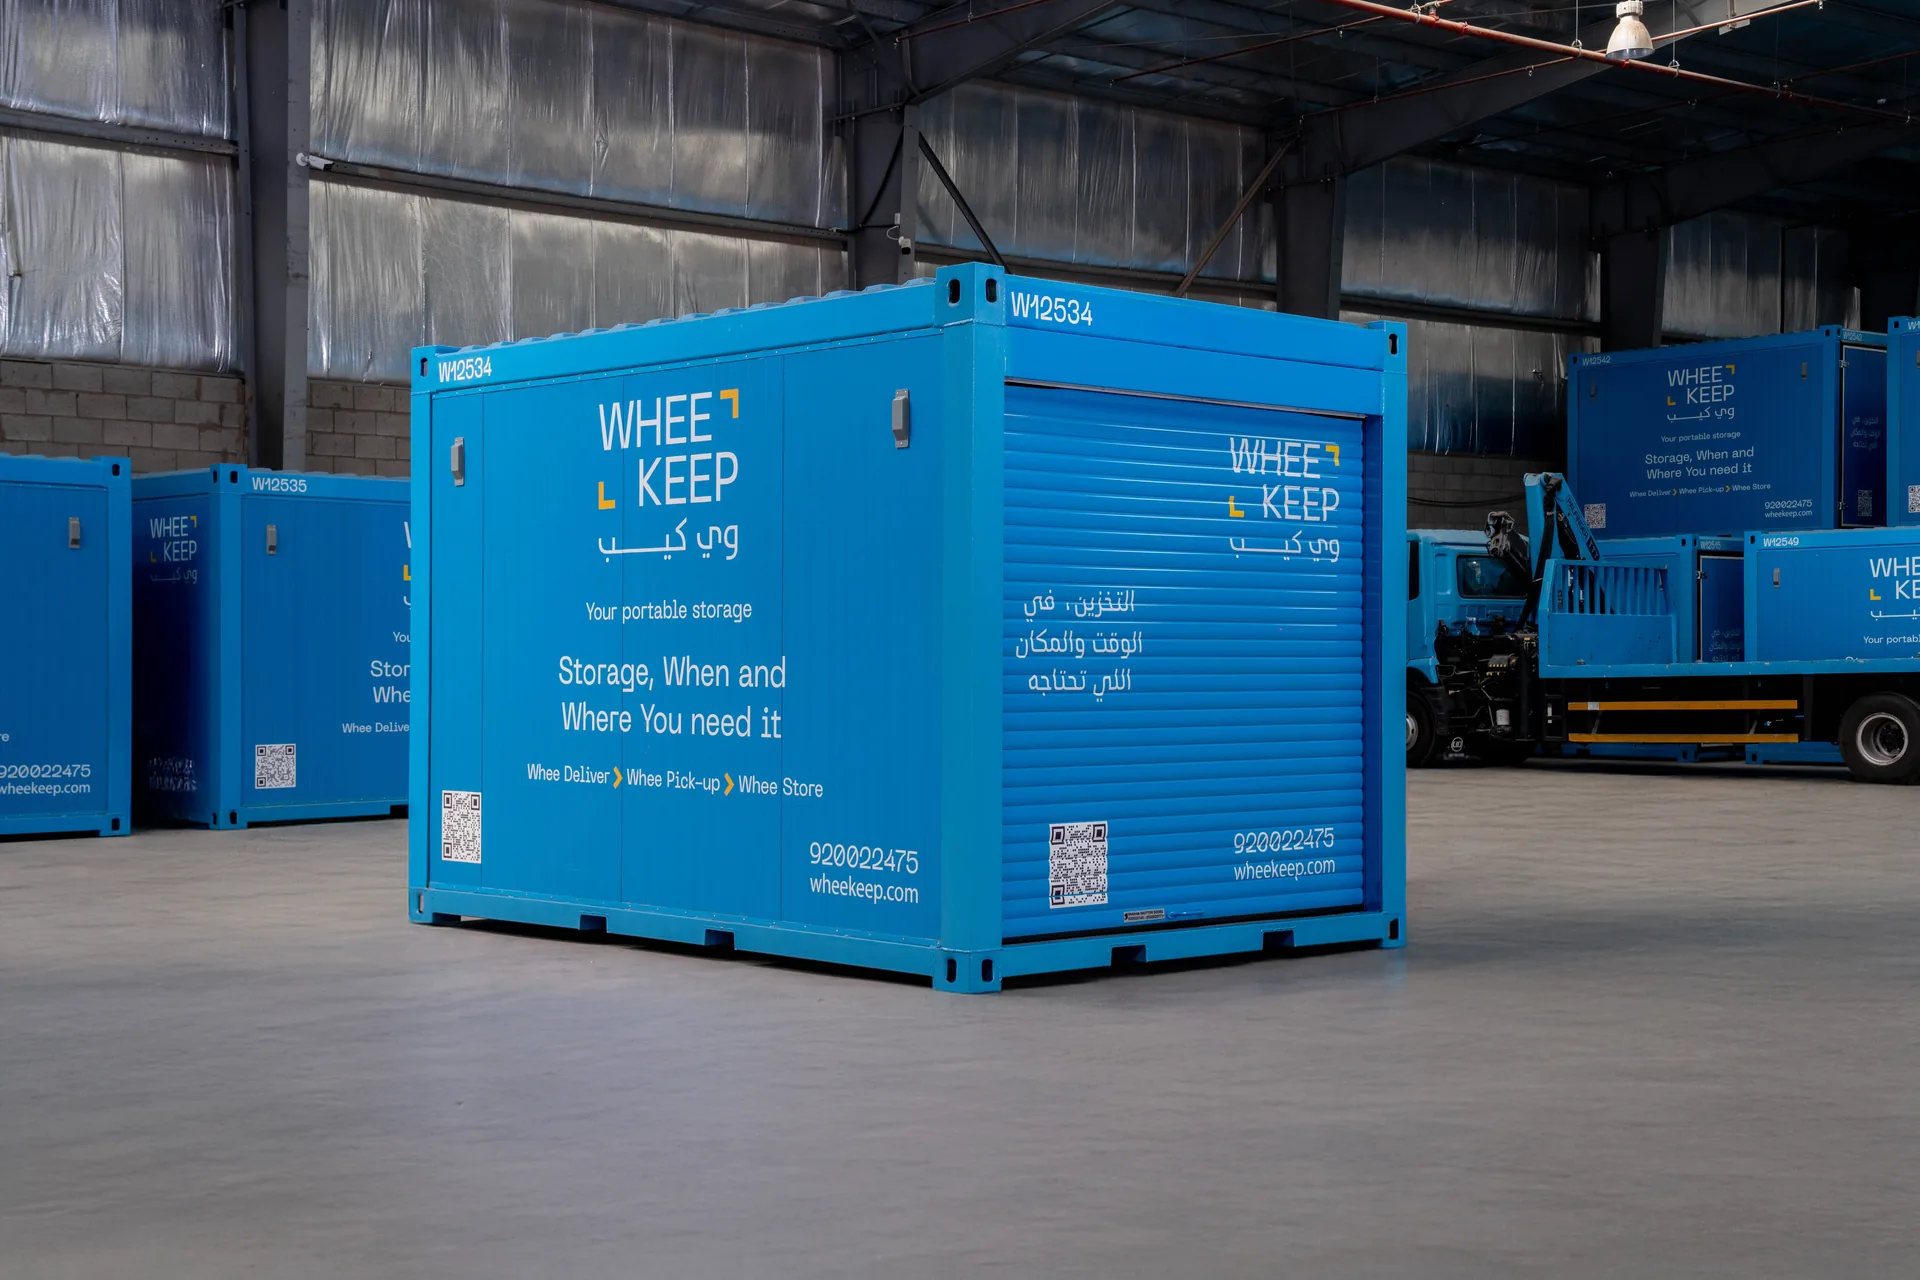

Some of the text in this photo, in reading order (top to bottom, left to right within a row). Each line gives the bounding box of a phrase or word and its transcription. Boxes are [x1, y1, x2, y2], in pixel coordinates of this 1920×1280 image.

[1011, 292, 1092, 325] W12534
[439, 357, 491, 382] W12534
[1668, 366, 1722, 387] WHEE
[1688, 385, 1734, 404] KEEP
[599, 392, 712, 450] WHEE
[1678, 433, 1711, 442] portable
[1712, 431, 1741, 440] storage
[1228, 435, 1320, 478] WHEE
[1645, 446, 1755, 465] Storage, When and
[639, 452, 738, 506] KEEP
[1647, 462, 1752, 480] Where You need it
[253, 478, 306, 492] W12535
[1260, 485, 1339, 521] KEEP
[1764, 499, 1812, 509] 920022475
[1764, 509, 1812, 518] wheekeep.com
[151, 516, 188, 538] WHEE
[164, 540, 196, 561] KEEP
[1764, 537, 1799, 546] W12549
[1870, 556, 1920, 577] WHE
[586, 600, 752, 624] Your portable storage
[393, 632, 411, 643] You
[370, 660, 410, 678] Stor
[559, 656, 785, 692] Storage, When and
[373, 686, 410, 704] Whe
[343, 722, 410, 733] Whee Delive
[562, 702, 781, 738] Where You need it
[0, 765, 90, 778] 920022475
[528, 764, 823, 797] Whee Deliver Whee Pick-up Whee Store
[0, 782, 90, 796] wheekeep.com
[1234, 828, 1334, 853] 920022475
[810, 842, 918, 876] 920022475
[1234, 860, 1335, 880] wheekeep.com
[810, 871, 918, 904] wheekeep.com
